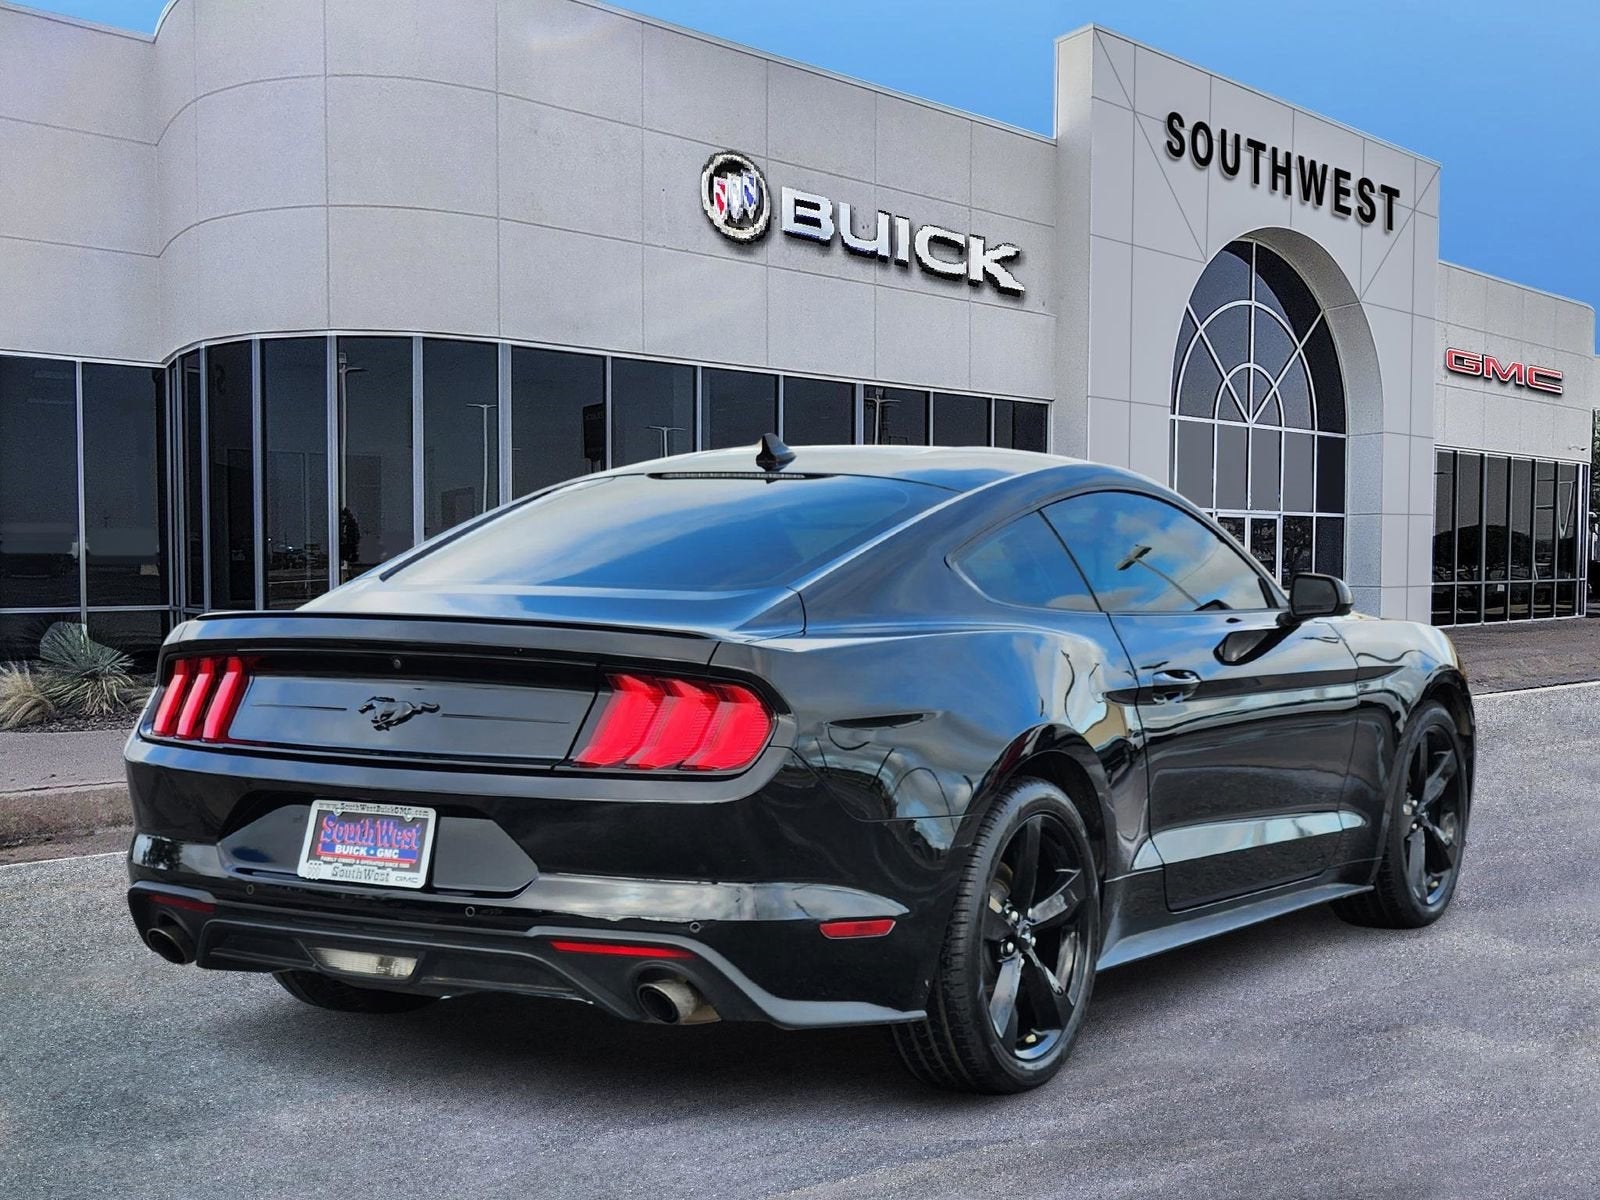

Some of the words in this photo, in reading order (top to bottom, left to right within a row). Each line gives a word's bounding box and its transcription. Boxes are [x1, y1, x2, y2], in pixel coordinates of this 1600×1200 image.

[1166, 111, 1400, 232] SOUTHWEST
[780, 186, 1025, 297] BUICK
[1445, 347, 1563, 395] GMC
[335, 845, 367, 856] BUICK
[376, 848, 400, 859] GMC
